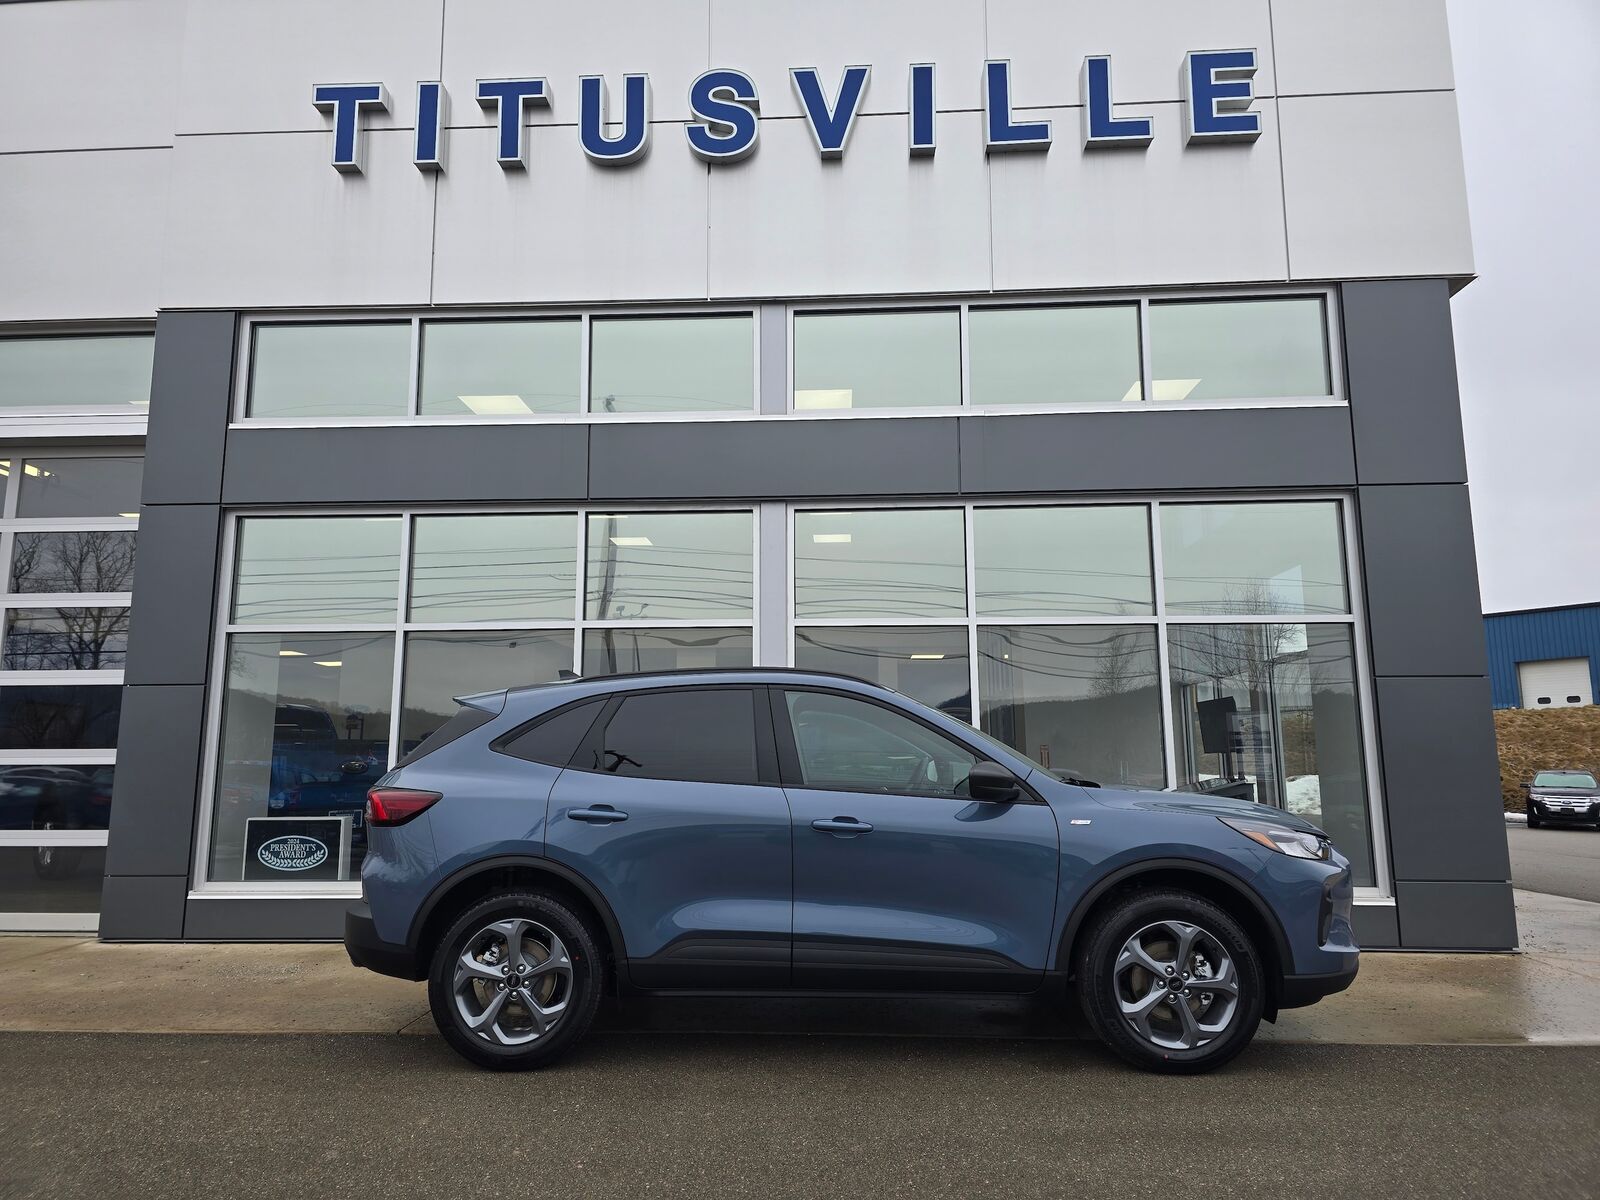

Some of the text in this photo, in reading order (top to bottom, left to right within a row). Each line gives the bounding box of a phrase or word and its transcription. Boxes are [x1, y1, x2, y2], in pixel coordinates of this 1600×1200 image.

[312, 48, 1262, 174] TITUSVILLE
[270, 843, 317, 852] PRESIDENT'S
[278, 850, 307, 859] AWARD
